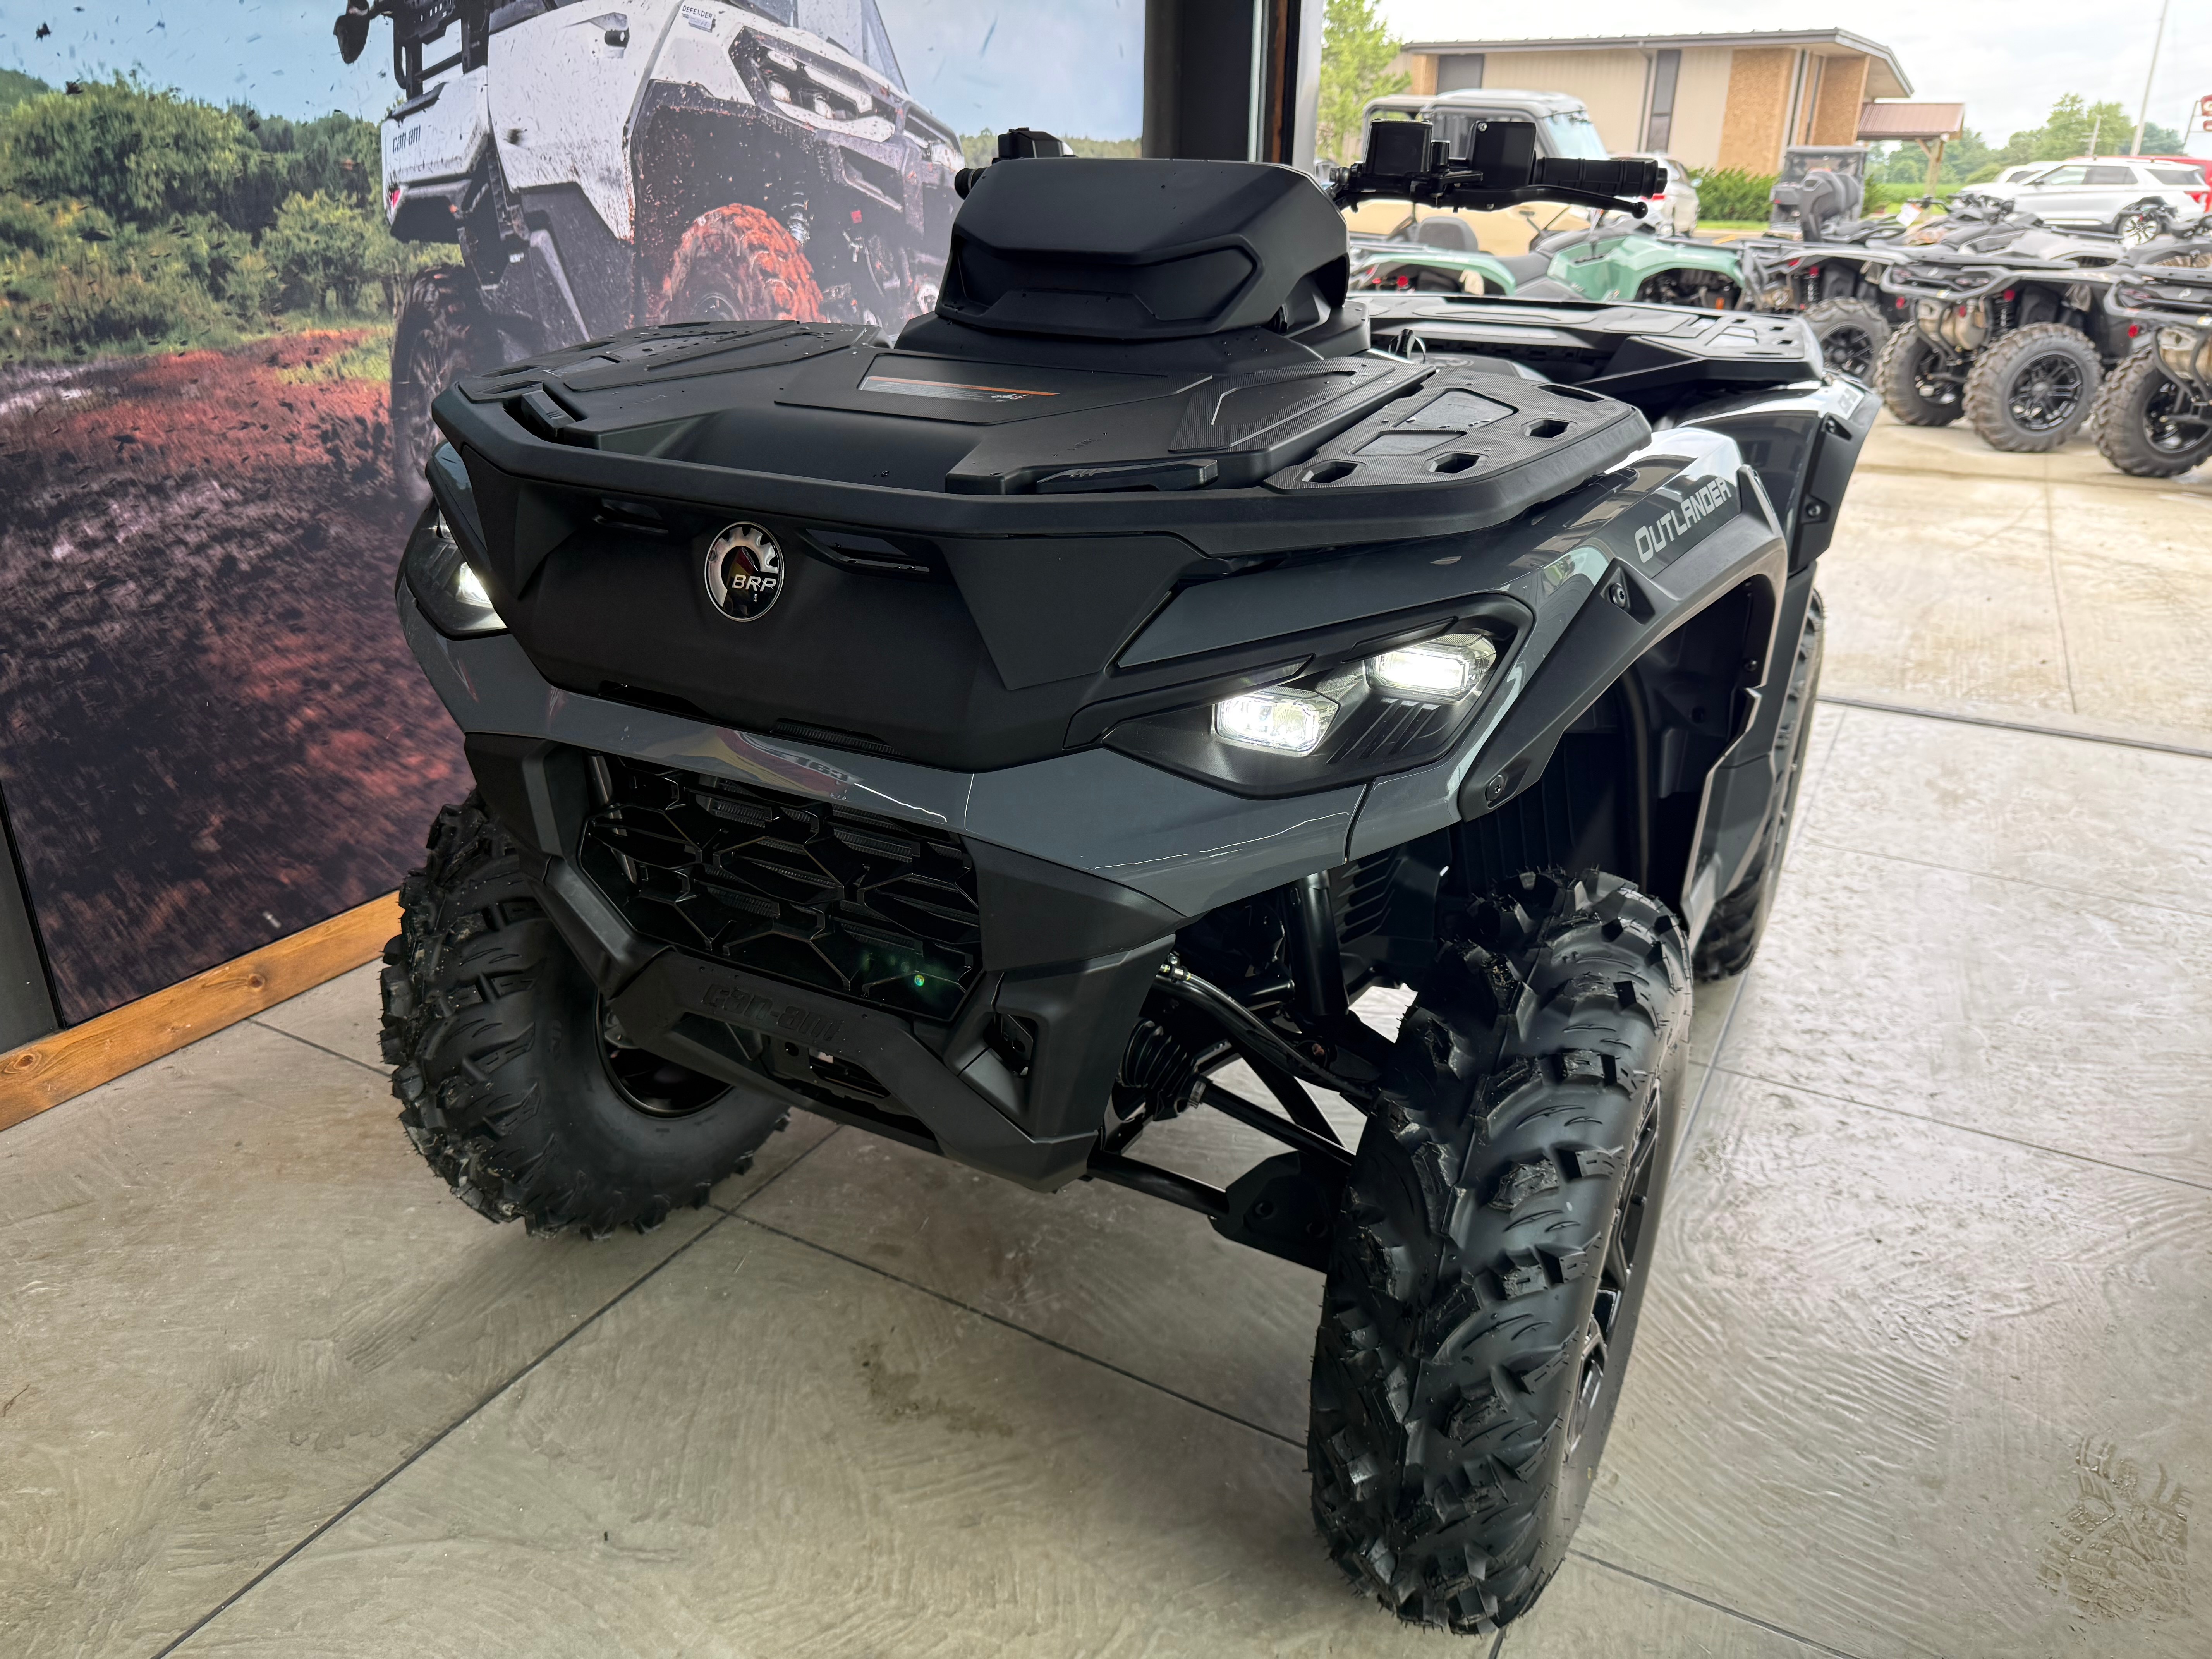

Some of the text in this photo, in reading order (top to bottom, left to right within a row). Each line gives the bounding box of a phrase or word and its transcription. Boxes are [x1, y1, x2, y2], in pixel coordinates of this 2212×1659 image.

[1635, 477, 1731, 563] OUTLANDER
[732, 574, 777, 592] BRP
[702, 983, 844, 1041] can-am
